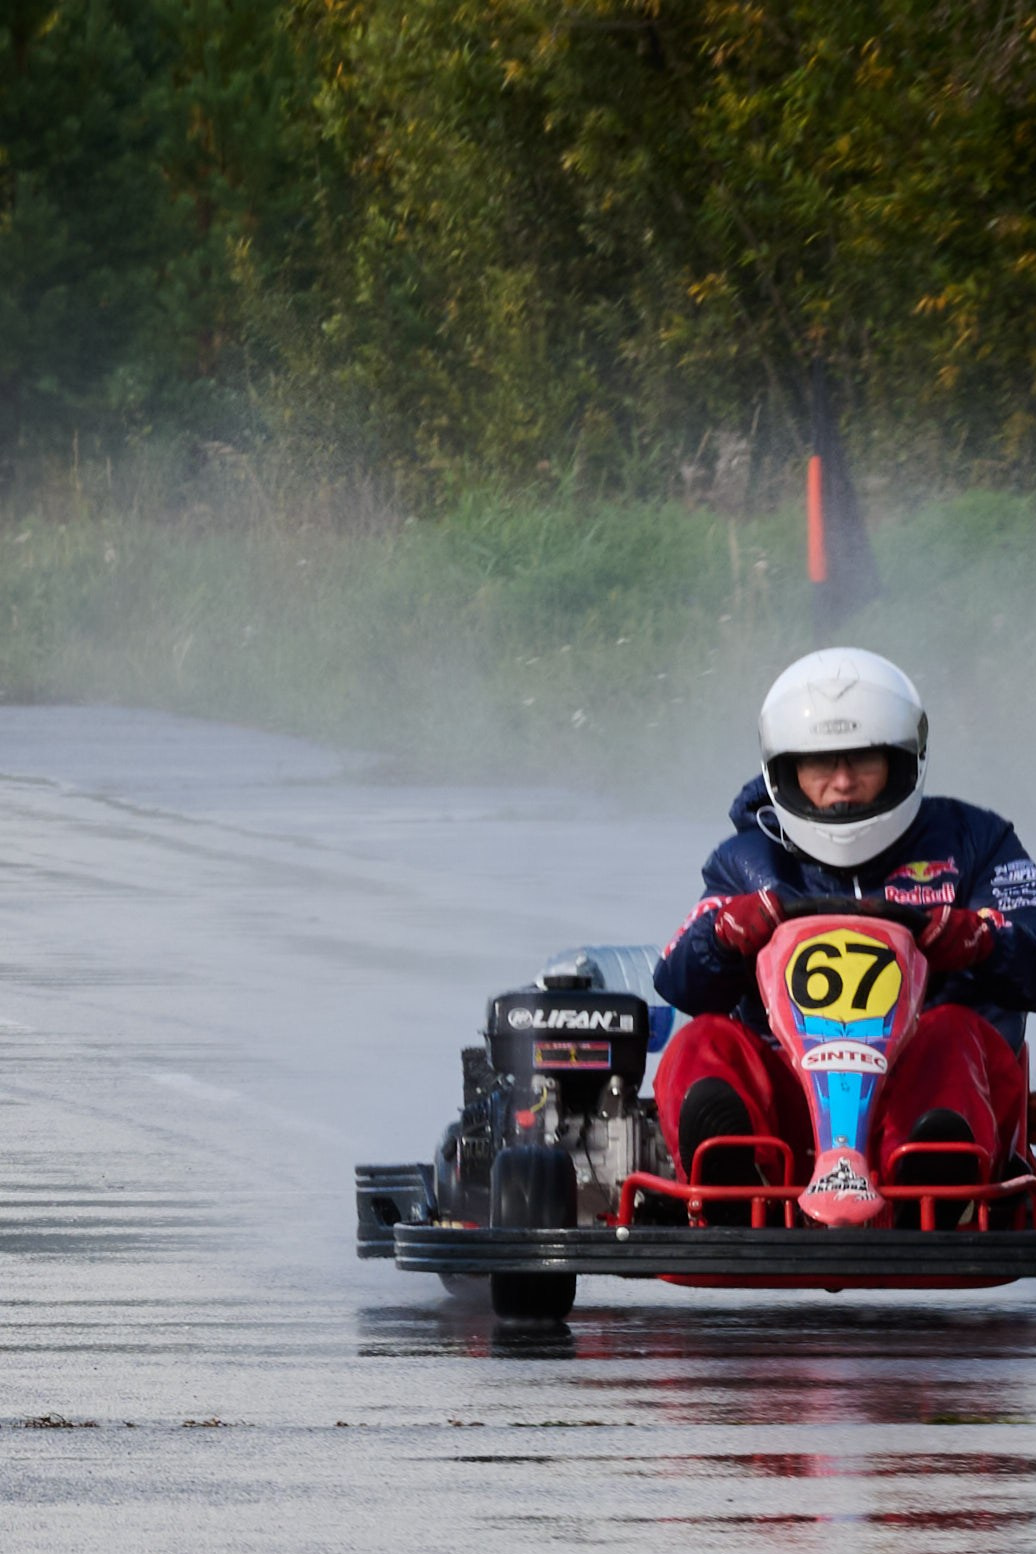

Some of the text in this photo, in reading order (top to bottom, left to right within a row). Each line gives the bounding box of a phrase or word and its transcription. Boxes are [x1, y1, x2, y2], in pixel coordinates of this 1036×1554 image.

[885, 882, 956, 906] Red Bull
[791, 942, 897, 1010] 67
[532, 1009, 614, 1030] LIFAN
[807, 1050, 885, 1071] SINTEC
